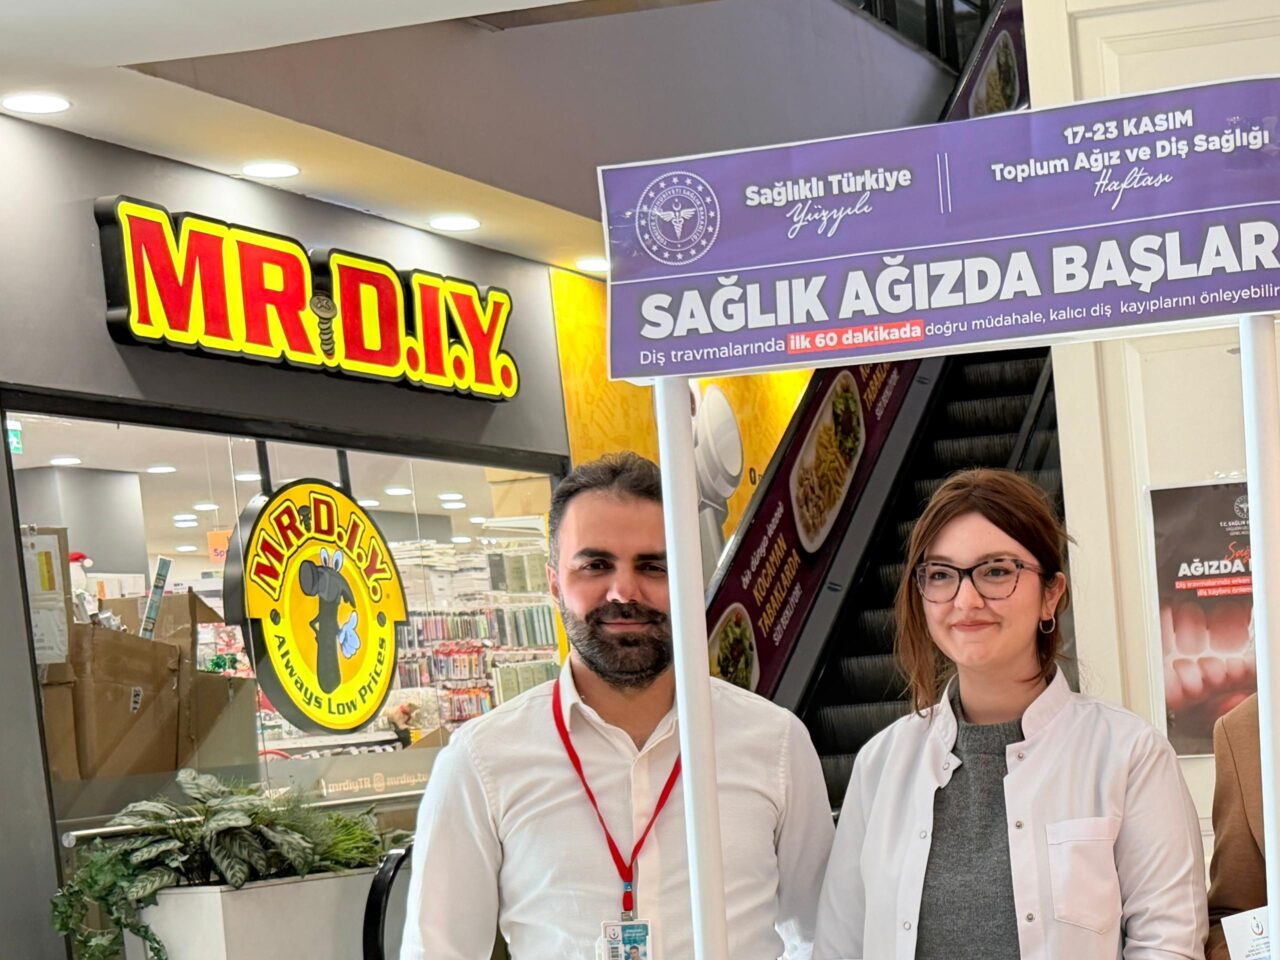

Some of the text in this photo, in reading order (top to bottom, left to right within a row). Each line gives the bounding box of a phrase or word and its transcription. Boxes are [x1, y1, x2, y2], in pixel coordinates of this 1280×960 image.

[1063, 109, 1194, 146] 17-23 KASIM
[991, 126, 1271, 183] Toplum Ağız ve Diş Sağlığı
[744, 167, 913, 208] Sağlıklı Türkiye
[1094, 167, 1174, 211] Haftası
[786, 190, 874, 240] Yüzyılı
[639, 220, 1280, 340] SAĞLIK AĞIZDA BAŞLAR
[640, 349, 666, 366] Diş
[671, 338, 786, 364] travmalarında
[790, 333, 811, 351] ilk
[815, 331, 838, 348] 60
[842, 322, 922, 346] dakikada
[925, 319, 968, 338] doğru
[972, 310, 1046, 331] müdahale,
[1050, 304, 1086, 321] kalıcı
[1090, 302, 1113, 319] diş
[1119, 292, 1197, 316] kayıplarını
[752, 532, 787, 607] KOCAMAN
[1178, 558, 1245, 577] AĞIZDA
[1224, 540, 1251, 564] Sağ
[757, 548, 801, 638] TABAKLARDA
[274, 633, 387, 716] Always Low Prices
